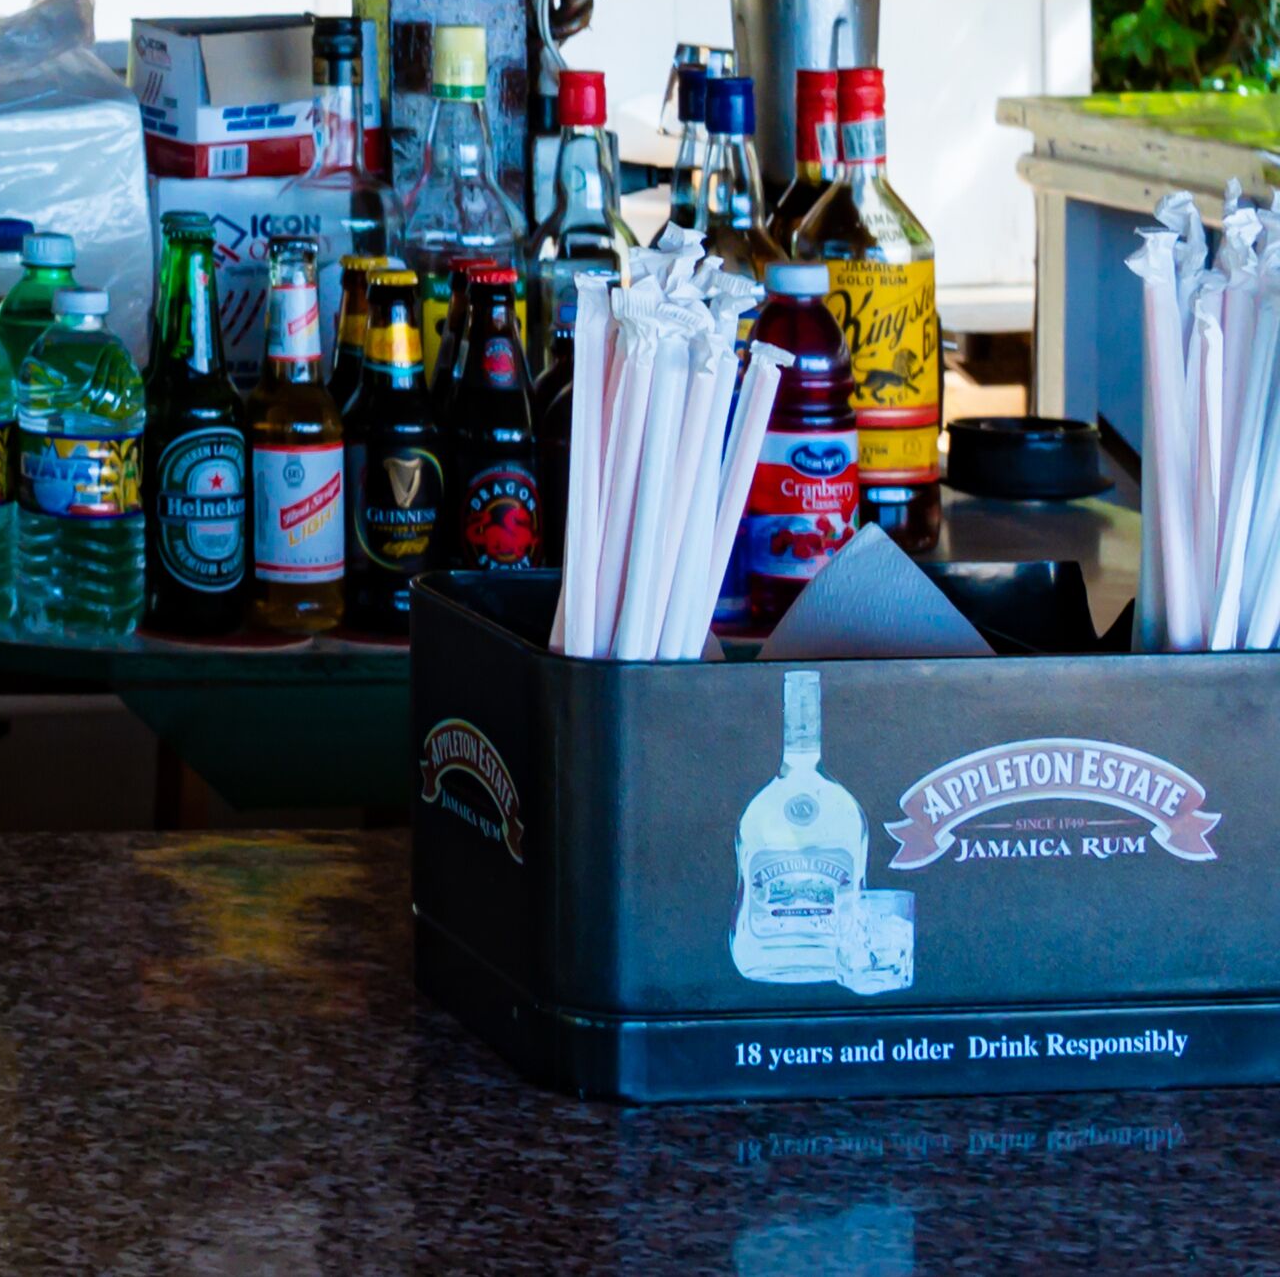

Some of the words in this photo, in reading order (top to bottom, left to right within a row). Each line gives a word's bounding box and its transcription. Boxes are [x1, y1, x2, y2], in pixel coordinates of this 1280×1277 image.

[250, 214, 322, 237] ICON
[837, 275, 874, 286] GOLD
[880, 275, 909, 286] RUM
[470, 481, 536, 511] DRAGON
[781, 478, 854, 502] Cranberry
[167, 496, 245, 518] Heineke
[366, 507, 436, 524] GUINNESS
[287, 498, 338, 547] LIGHT
[431, 730, 478, 769] APPLETON
[479, 740, 514, 816] ESTATE
[923, 751, 1072, 823] APPLETON
[1079, 749, 1186, 817] ESTATE
[441, 788, 477, 826] JAMAICA
[1016, 818, 1055, 830] SINCE
[1059, 818, 1085, 830] 1749
[955, 838, 1072, 862] JAMAICA
[1081, 836, 1147, 859] RUM
[760, 859, 808, 882] APPLETON
[809, 858, 843, 881] ESTATE
[734, 1042, 762, 1066] 18
[768, 1043, 833, 1070] years
[840, 1039, 885, 1063] and
[892, 1037, 954, 1061] older
[967, 1034, 1039, 1059] Drink
[1045, 1029, 1189, 1061] Responsibly
